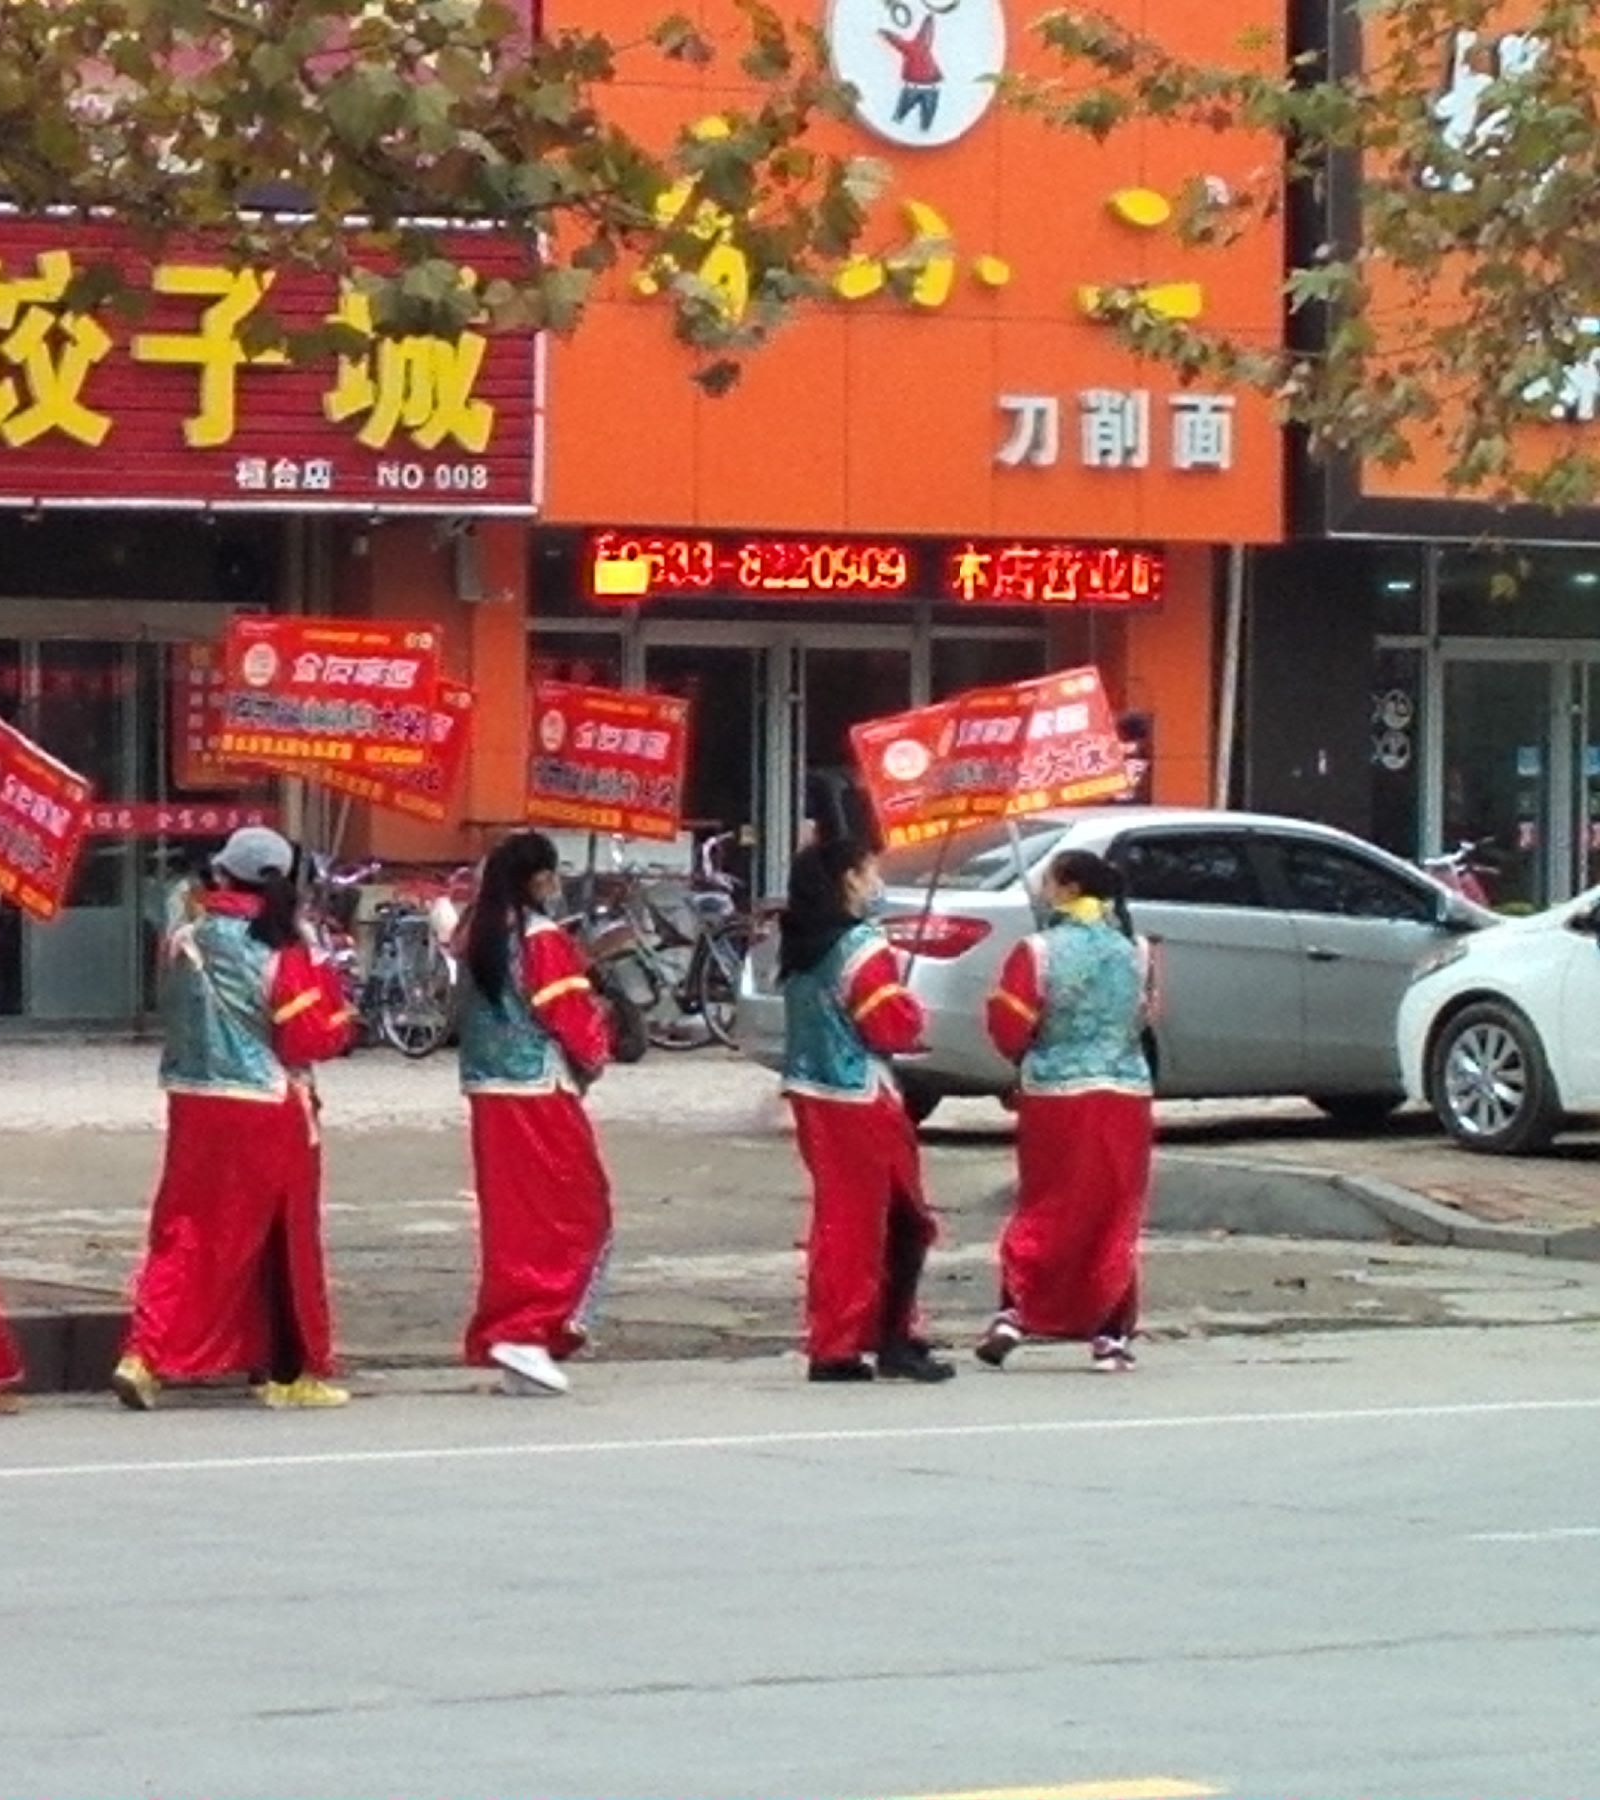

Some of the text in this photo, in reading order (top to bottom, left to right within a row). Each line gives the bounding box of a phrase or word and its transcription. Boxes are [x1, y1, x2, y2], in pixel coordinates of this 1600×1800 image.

[994, 388, 1238, 470] 刀削面
[377, 461, 424, 490] NO
